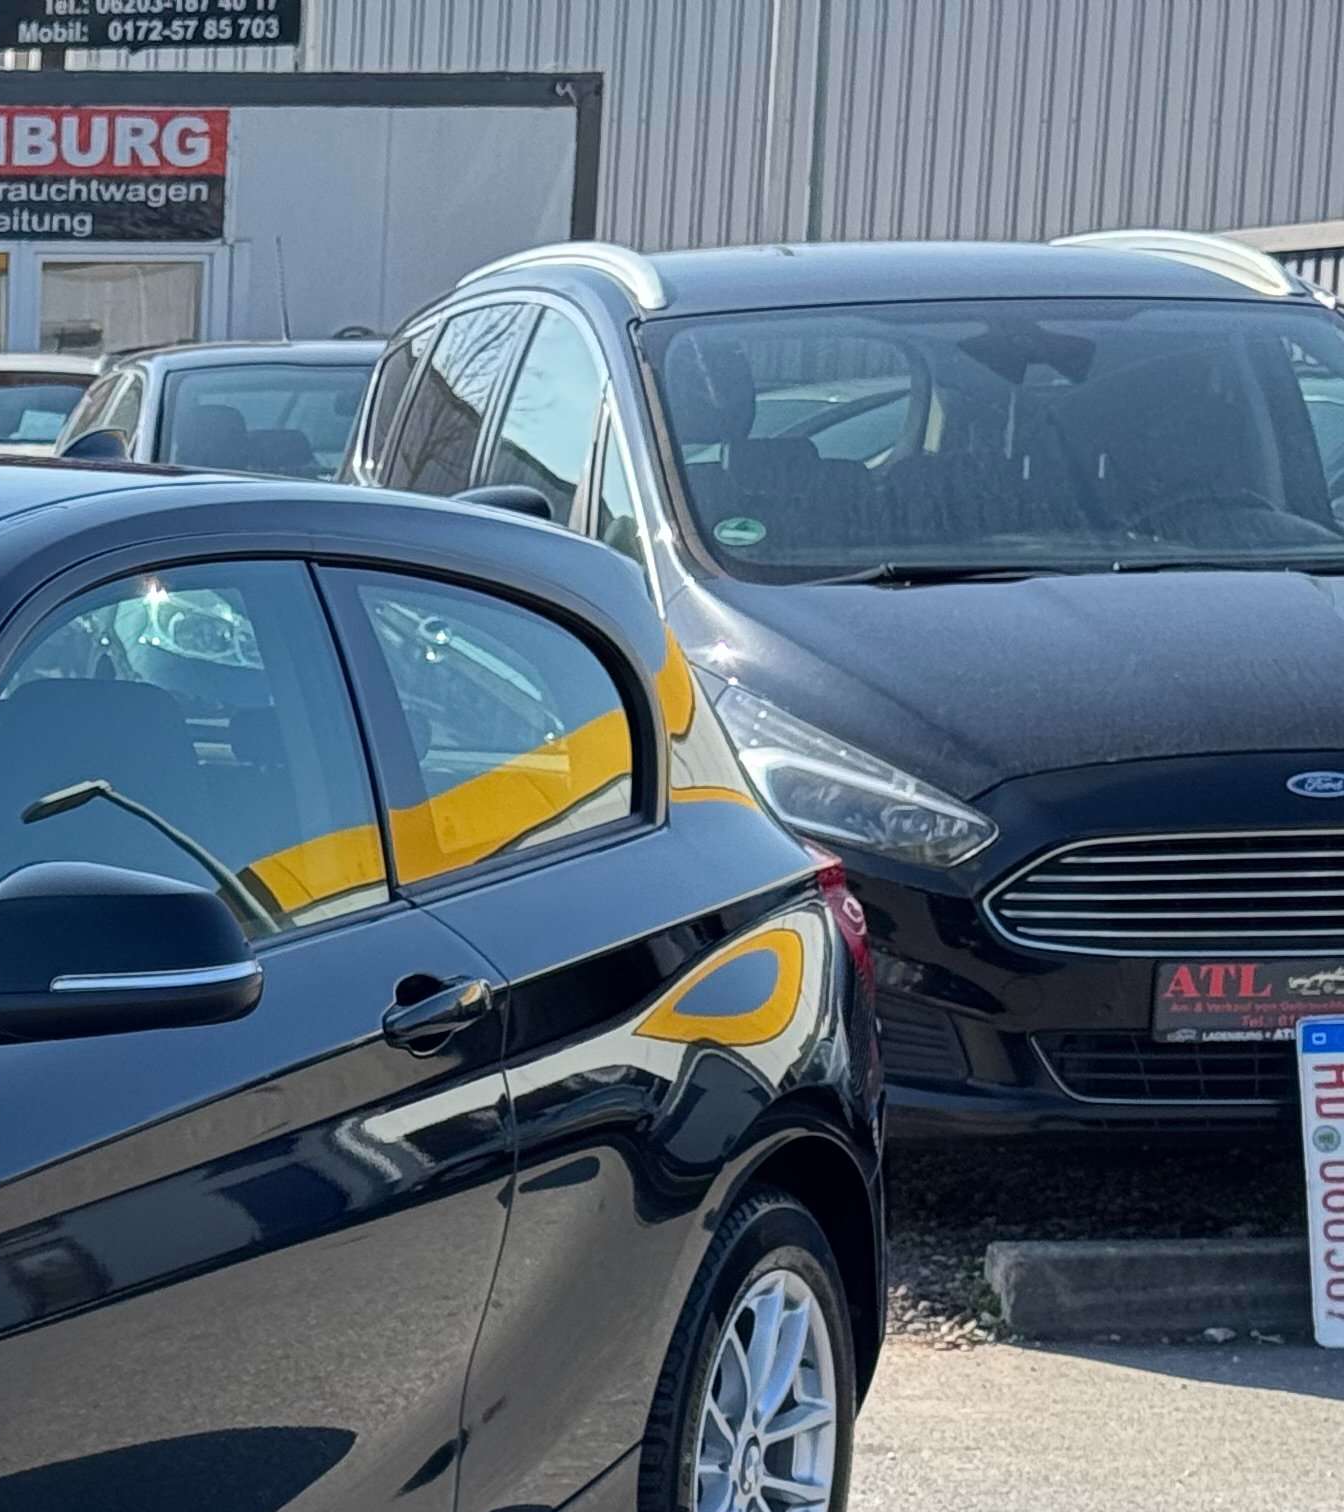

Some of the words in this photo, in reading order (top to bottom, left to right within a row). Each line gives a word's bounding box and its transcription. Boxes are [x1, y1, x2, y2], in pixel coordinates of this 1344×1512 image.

[18, 21, 89, 43] Mobil:
[108, 17, 199, 42] 0172-57
[203, 17, 233, 40] 85
[238, 16, 280, 40] 703
[1162, 962, 1273, 998] ATL
